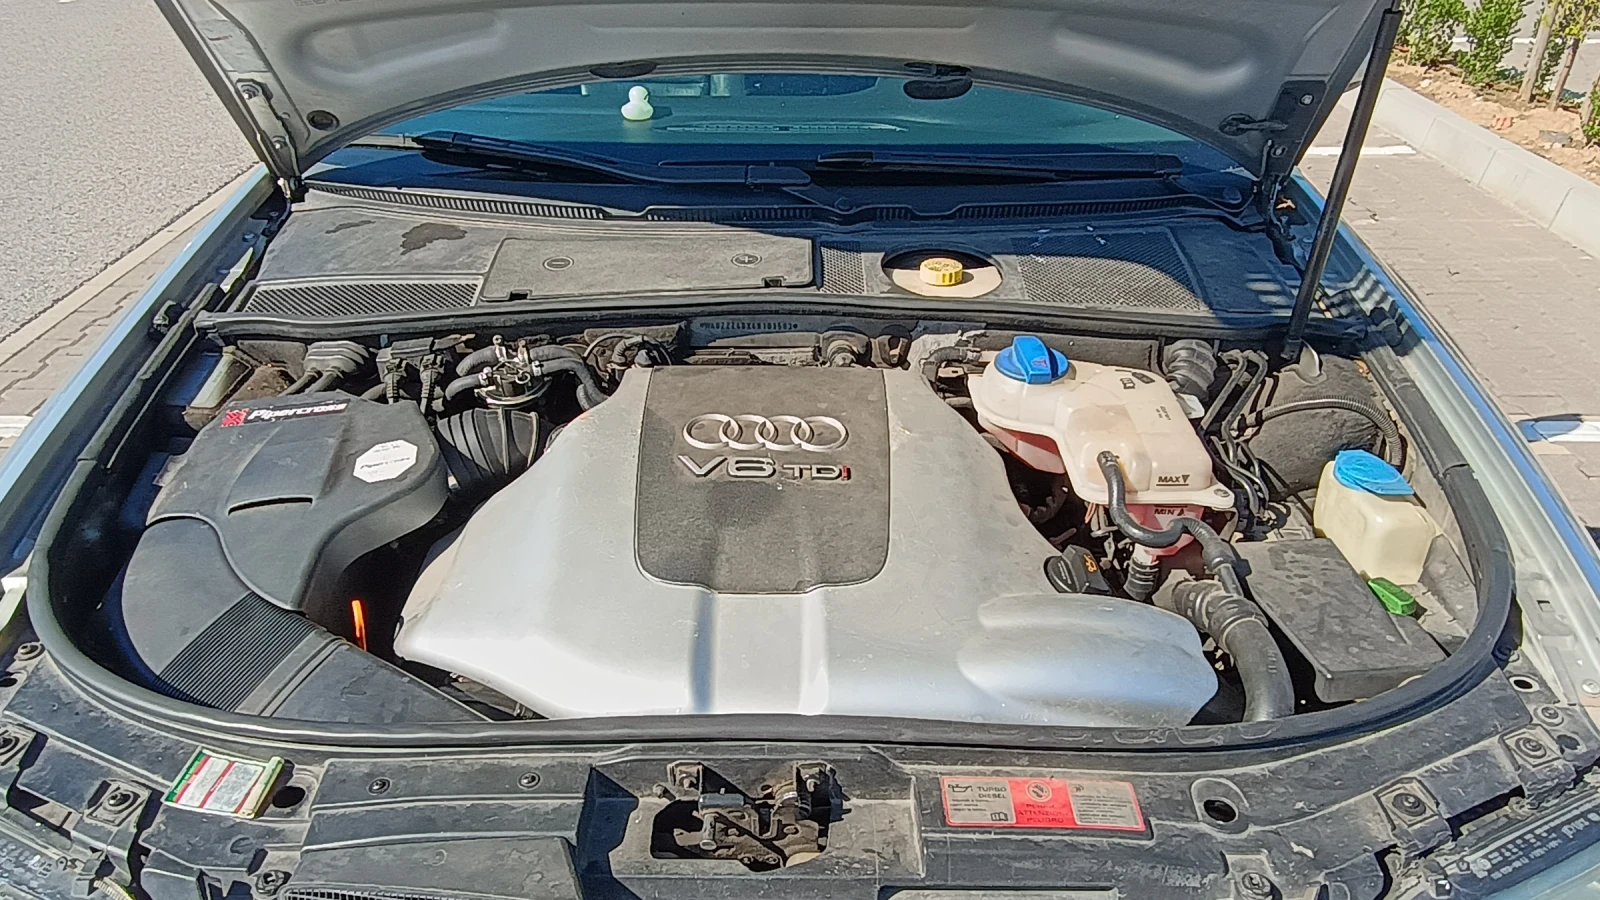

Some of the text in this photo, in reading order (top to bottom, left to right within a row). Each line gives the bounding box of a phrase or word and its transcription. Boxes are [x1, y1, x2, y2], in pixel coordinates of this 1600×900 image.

[247, 403, 348, 420] Pipercross
[677, 455, 776, 478] V6
[1158, 475, 1181, 484] MAX
[1154, 508, 1176, 516] MIN
